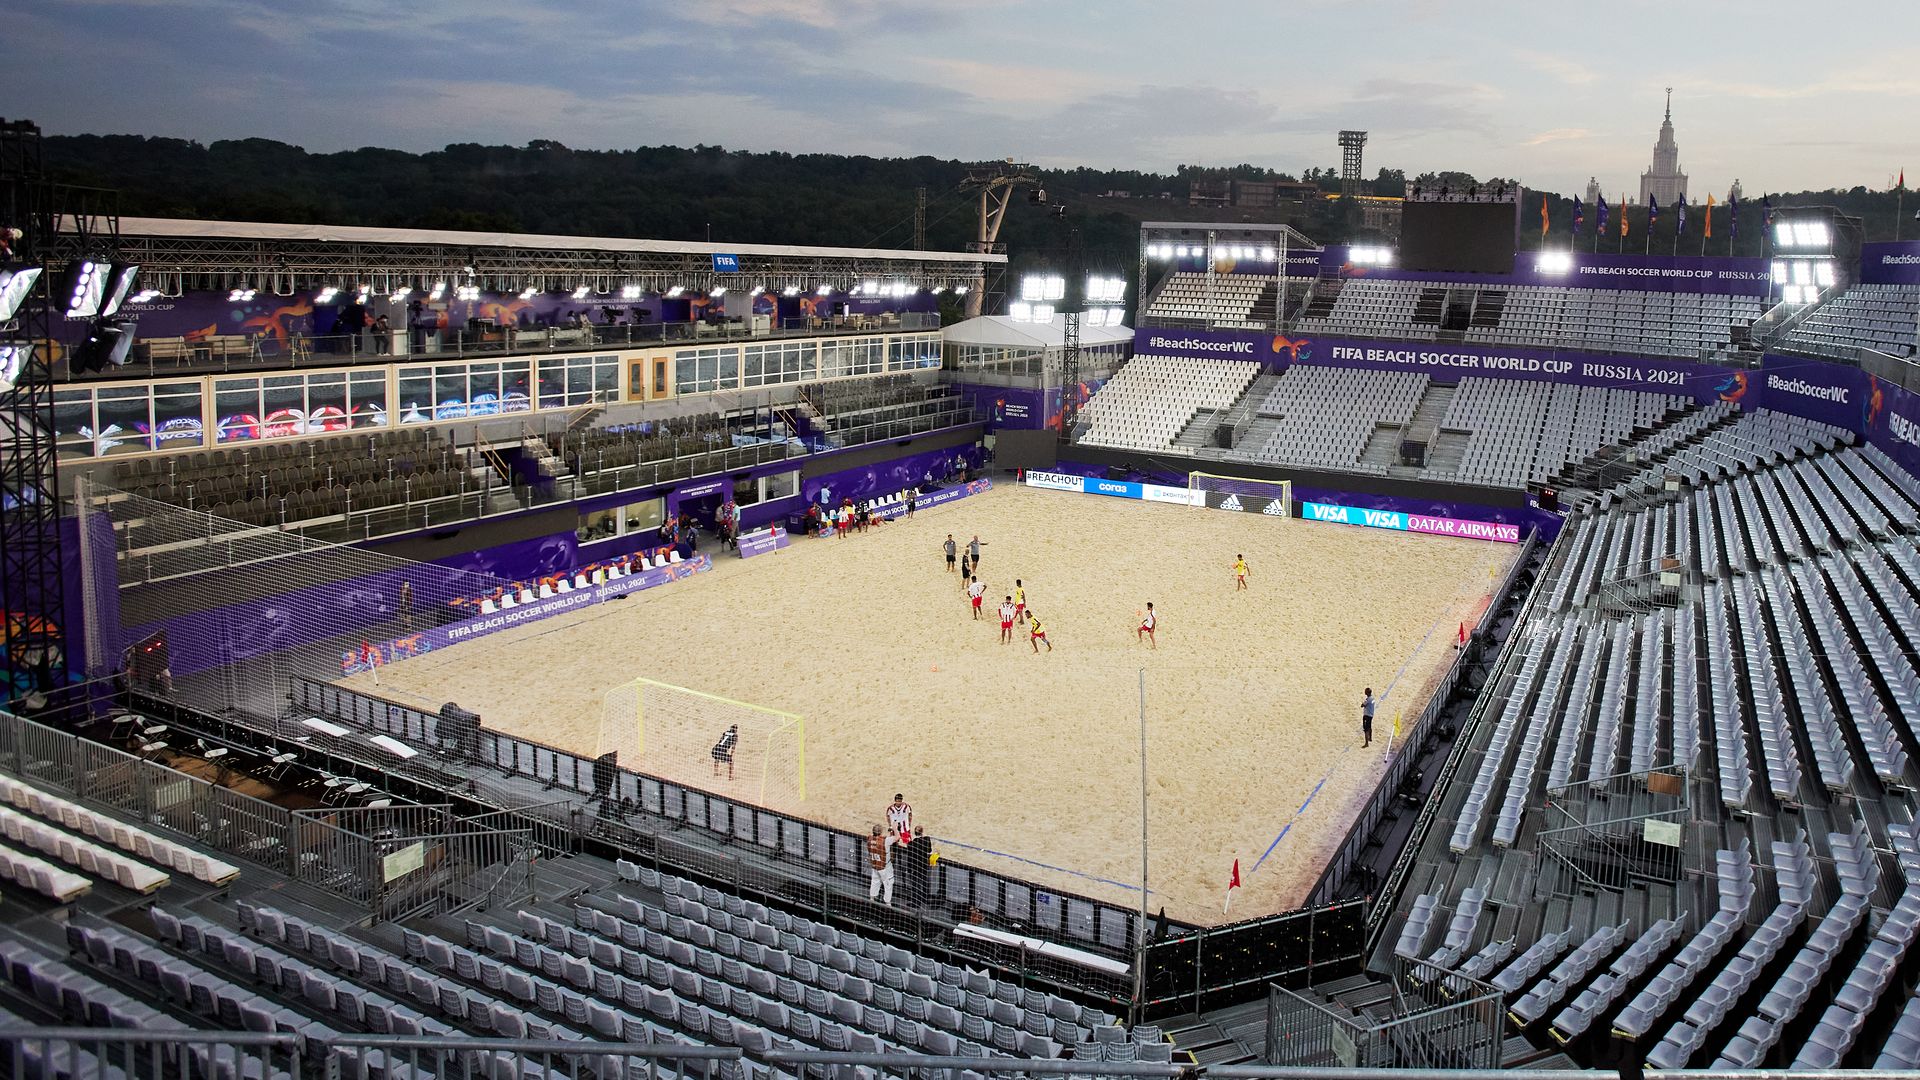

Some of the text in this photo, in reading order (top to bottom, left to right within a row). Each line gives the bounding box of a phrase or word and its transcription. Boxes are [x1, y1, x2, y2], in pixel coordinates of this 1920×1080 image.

[716, 257, 736, 266] FIFA
[1580, 266, 1770, 280] FIFA BEACH SOCCER WORLD CUP RUSSIA 20
[1149, 337, 1254, 353] #BeachSoccerWC
[1332, 347, 1364, 361] FIFA
[1366, 349, 1416, 364] BEACH
[1419, 351, 1479, 368] SOCCER
[1482, 355, 1540, 372] WORLD
[1543, 360, 1573, 374] CUP
[1582, 363, 1643, 381] RUSSIA
[1767, 374, 1849, 404] #BeachSoccerWC
[1027, 472, 1084, 486] #REACHOUT
[1310, 504, 1348, 522] VISA
[1362, 510, 1400, 528] VISA
[1408, 517, 1518, 540] QATAR AIRWAYS
[449, 626, 472, 639] FIFA
[472, 615, 505, 633] BEACH
[505, 606, 542, 625] SOCCER
[542, 597, 574, 615] WORLD
[574, 592, 592, 606] CUP
[595, 583, 627, 598] RUSSIA
